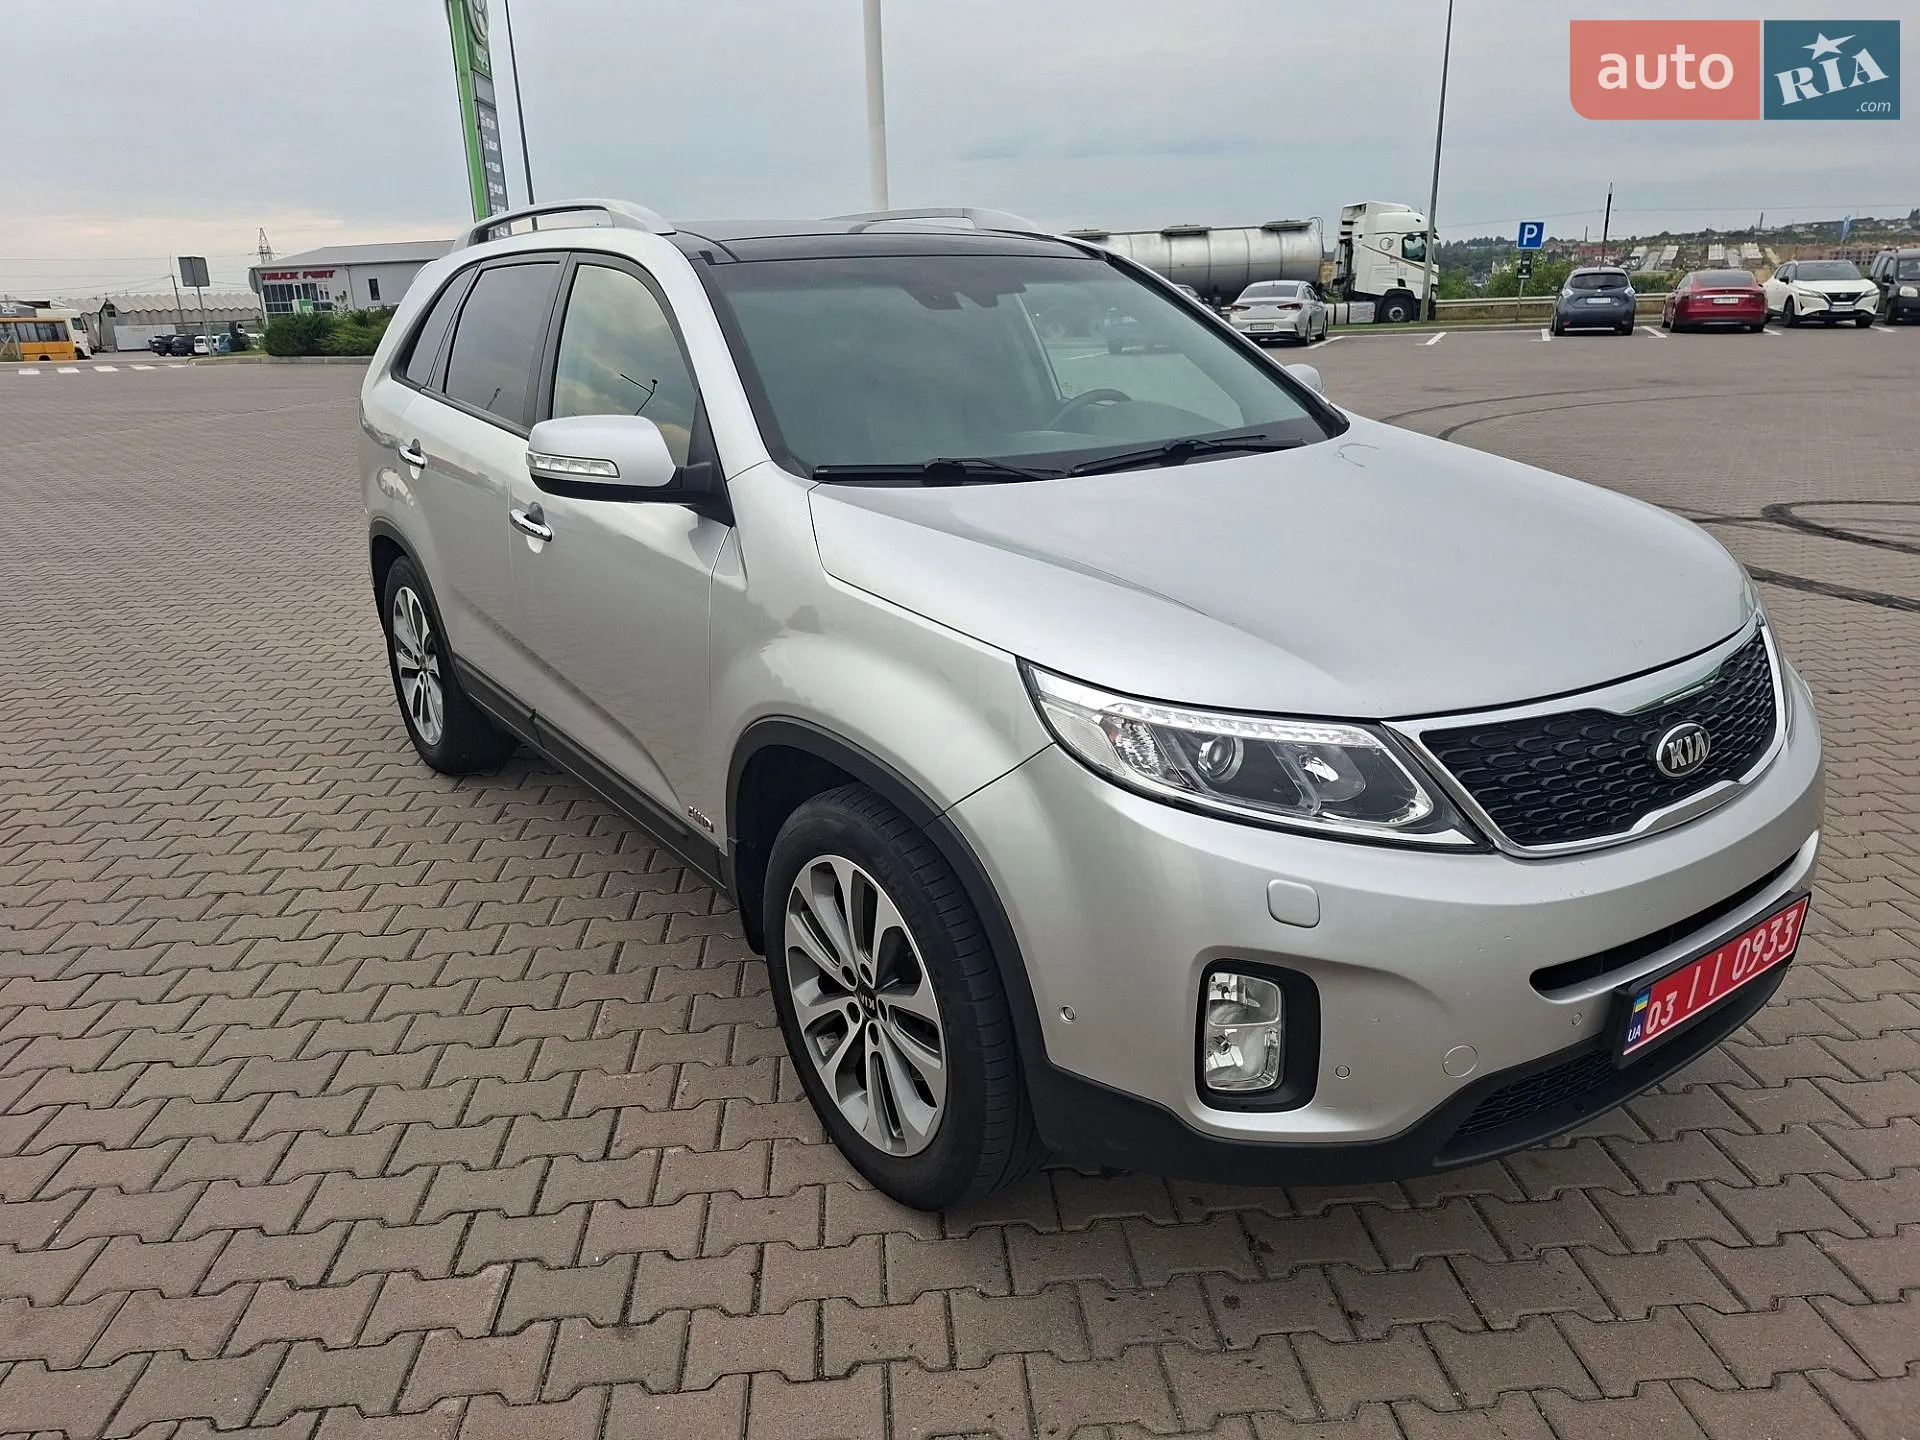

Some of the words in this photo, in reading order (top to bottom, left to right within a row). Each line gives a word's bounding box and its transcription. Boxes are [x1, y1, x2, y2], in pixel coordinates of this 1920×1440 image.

[1523, 224, 1538, 246] P
[1666, 731, 1707, 770] KIA
[1645, 991, 1678, 1034] 03
[1731, 908, 1798, 981] 0933
[1628, 1024, 1641, 1042] UA
